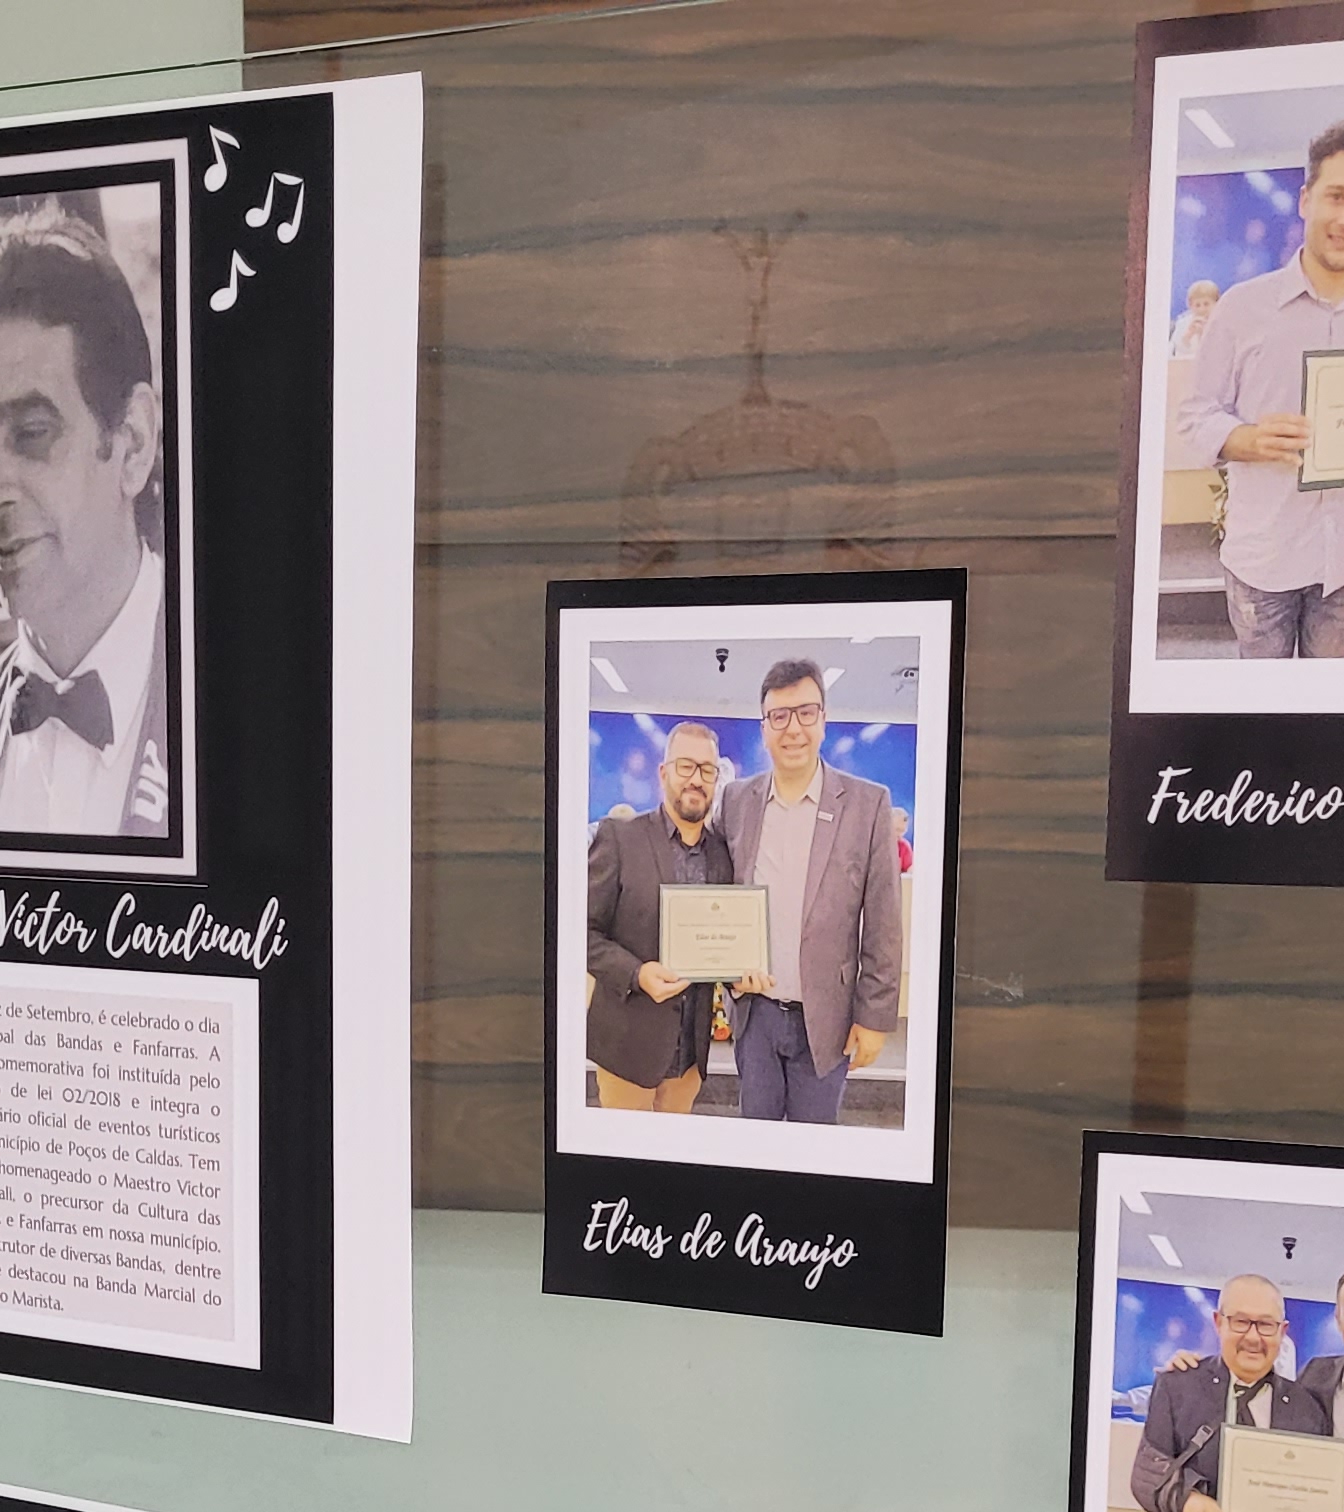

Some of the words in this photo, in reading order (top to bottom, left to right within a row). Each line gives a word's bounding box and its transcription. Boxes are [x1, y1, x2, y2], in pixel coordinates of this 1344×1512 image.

[105, 892, 288, 970] Cardinali
[6, 1002, 23, 1018] de
[27, 1004, 93, 1025] Setembro,
[99, 1010, 106, 1025] é
[111, 1011, 180, 1030] celebrado
[184, 1020, 194, 1031] o
[199, 1017, 220, 1034] dia
[25, 1030, 46, 1047] das
[57, 1033, 102, 1051] Bandas
[114, 1041, 122, 1052] e
[133, 1039, 198, 1059] Fanfarras.
[209, 1046, 220, 1062] A
[93, 1063, 109, 1080] foi
[118, 1065, 181, 1085] instituída
[190, 1072, 220, 1092] pelo
[11, 1082, 27, 1098] de
[38, 1084, 52, 1100] lei
[131, 1097, 140, 1109] e
[150, 1096, 199, 1118] integra
[211, 1105, 220, 1117] o
[28, 1110, 66, 1128] oficial
[74, 1115, 91, 1131] de
[99, 1120, 151, 1137] eventos
[159, 1123, 220, 1144] turísticos
[46, 1138, 62, 1155] de
[69, 1141, 106, 1162] Poços
[112, 1145, 129, 1161] de
[136, 1149, 183, 1167] Caldas.
[188, 1153, 220, 1172] Tem
[98, 1174, 107, 1186] o
[114, 1173, 171, 1193] Maestro
[177, 1179, 220, 1199] Victor
[23, 1192, 32, 1203] o
[41, 1194, 104, 1212] precursor
[112, 1199, 129, 1215] da
[138, 1202, 188, 1222] Cultura
[198, 1208, 221, 1225] das
[6, 1216, 14, 1227] e
[19, 1214, 77, 1235] Fanfarras
[83, 1225, 103, 1238] em
[109, 1228, 144, 1243] nossa
[151, 1233, 221, 1255] município.
[582, 1196, 672, 1258] Elias
[680, 1212, 726, 1260] de
[734, 1212, 858, 1290] Araujo
[40, 1243, 56, 1258] de
[61, 1245, 111, 1265] diversas
[116, 1252, 165, 1274] Bandas,
[175, 1260, 221, 1280] dentre
[8, 1264, 66, 1285] destacou
[74, 1276, 89, 1288] na
[97, 1276, 137, 1295] Banda
[144, 1282, 195, 1304] Marcial
[203, 1290, 222, 1306] do
[12, 1290, 64, 1311] Marista.
